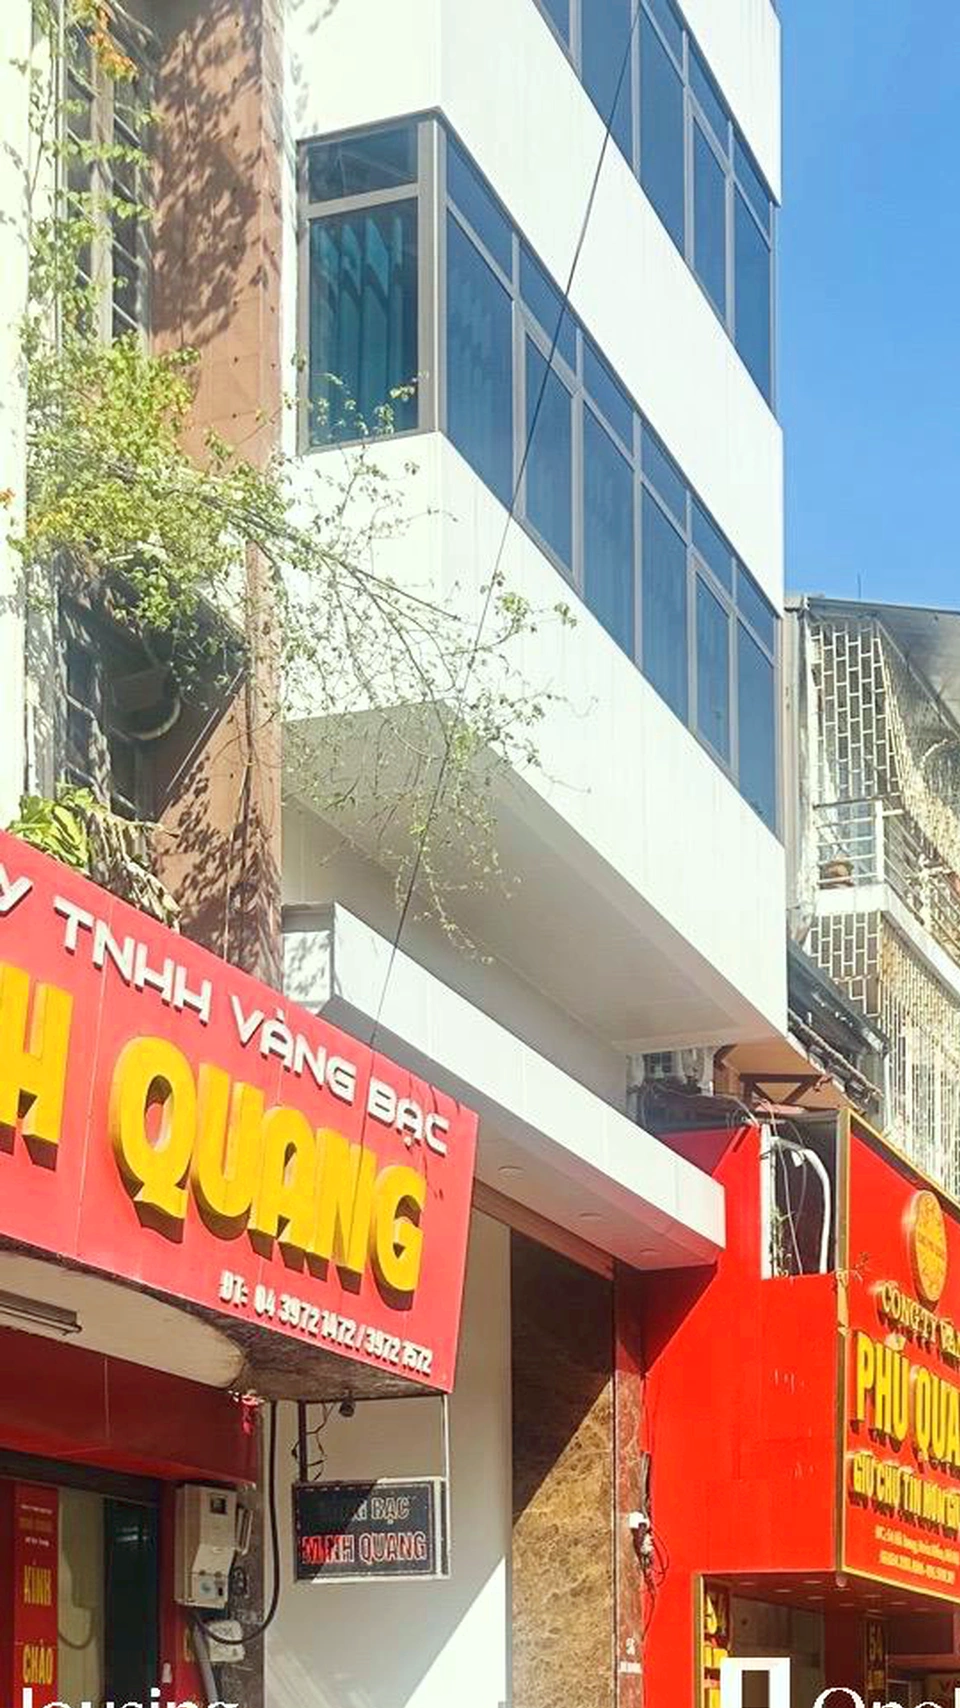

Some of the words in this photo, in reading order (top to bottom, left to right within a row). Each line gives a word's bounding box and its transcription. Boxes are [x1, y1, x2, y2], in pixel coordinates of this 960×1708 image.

[53, 895, 213, 1024] TNHH
[231, 994, 358, 1105] VÀNG
[367, 1076, 450, 1158] BẠC
[112, 1036, 427, 1308] QUANG
[254, 1284, 277, 1318] 04
[857, 1331, 910, 1440] PHÚ
[370, 1496, 410, 1525] BẠC
[359, 1531, 428, 1565] QUANG
